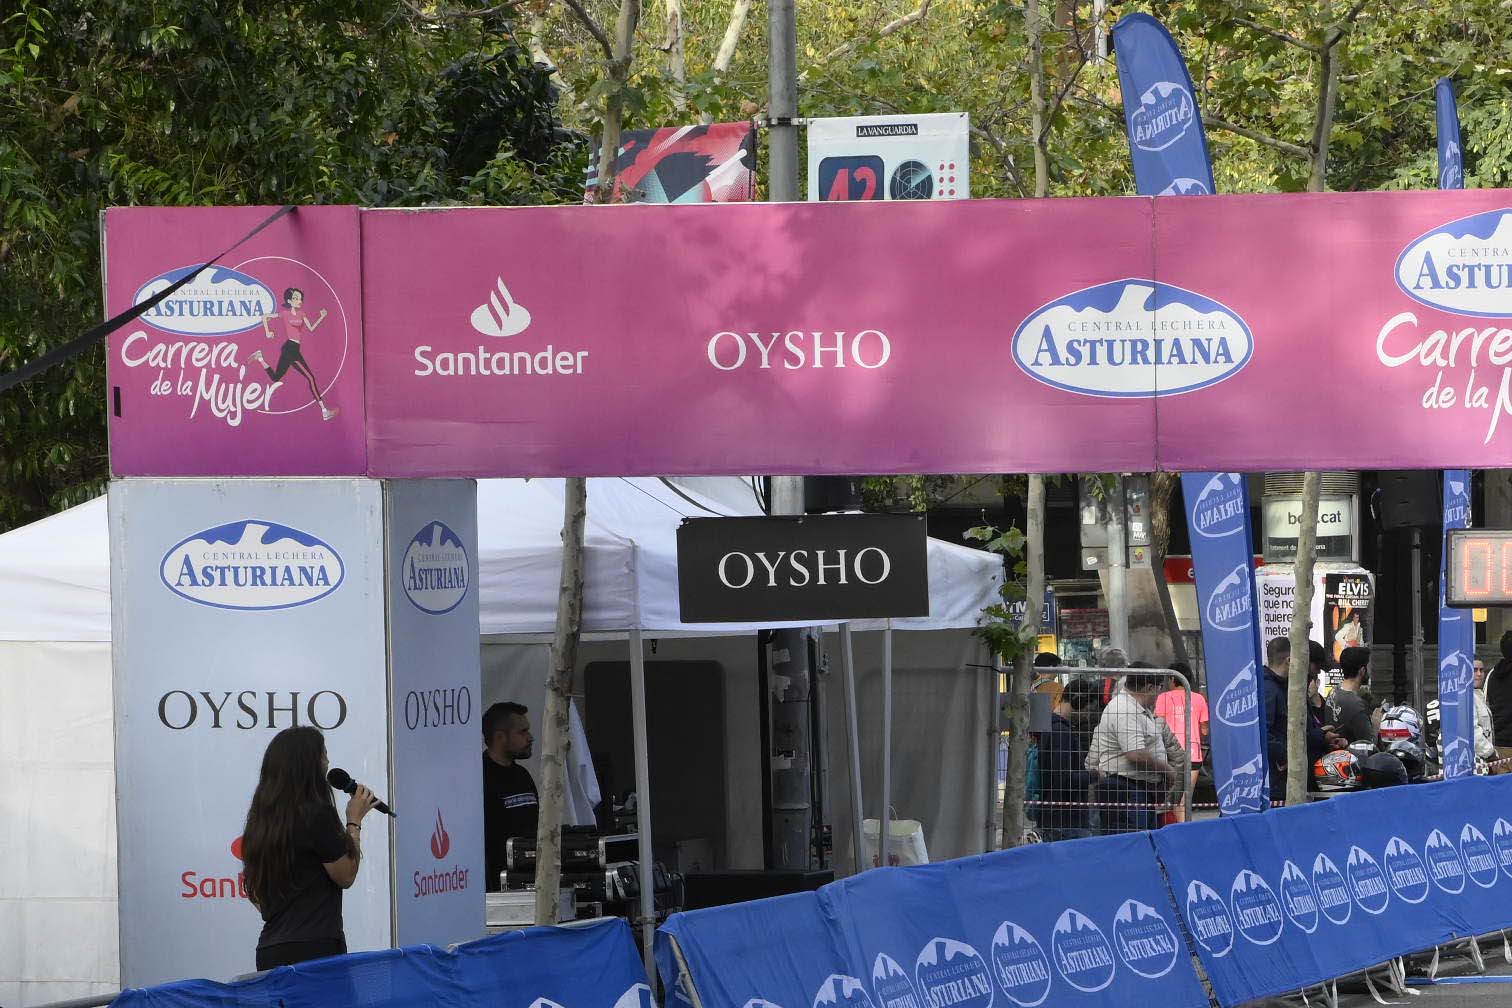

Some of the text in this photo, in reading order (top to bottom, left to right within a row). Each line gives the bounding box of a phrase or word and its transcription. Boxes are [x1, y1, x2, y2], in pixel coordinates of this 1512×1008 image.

[173, 288, 261, 297] ENTRAL LECHERA
[1068, 318, 1227, 333] CENTRAL LECHERA
[121, 330, 240, 368] Carrera
[414, 345, 590, 377] Santander
[706, 328, 893, 372] OYSHO
[1030, 323, 1235, 367] ASTURIANA
[150, 364, 284, 428] de la Mujer
[1422, 371, 1458, 410] de
[1463, 368, 1490, 410] la
[175, 553, 332, 588] ASTURIANA
[202, 551, 325, 561] CENTRAL LECHERA
[407, 555, 466, 592] ASTURIANA
[718, 546, 892, 590] OYSHO
[1263, 600, 1281, 610] que
[1338, 582, 1369, 596] ELVIS
[157, 689, 348, 731] OYSHO
[404, 685, 472, 731] OYSHO
[413, 864, 470, 899] Santander
[997, 956, 1048, 989] ASTURIANA
[1057, 942, 1112, 975] ASTURIANA
